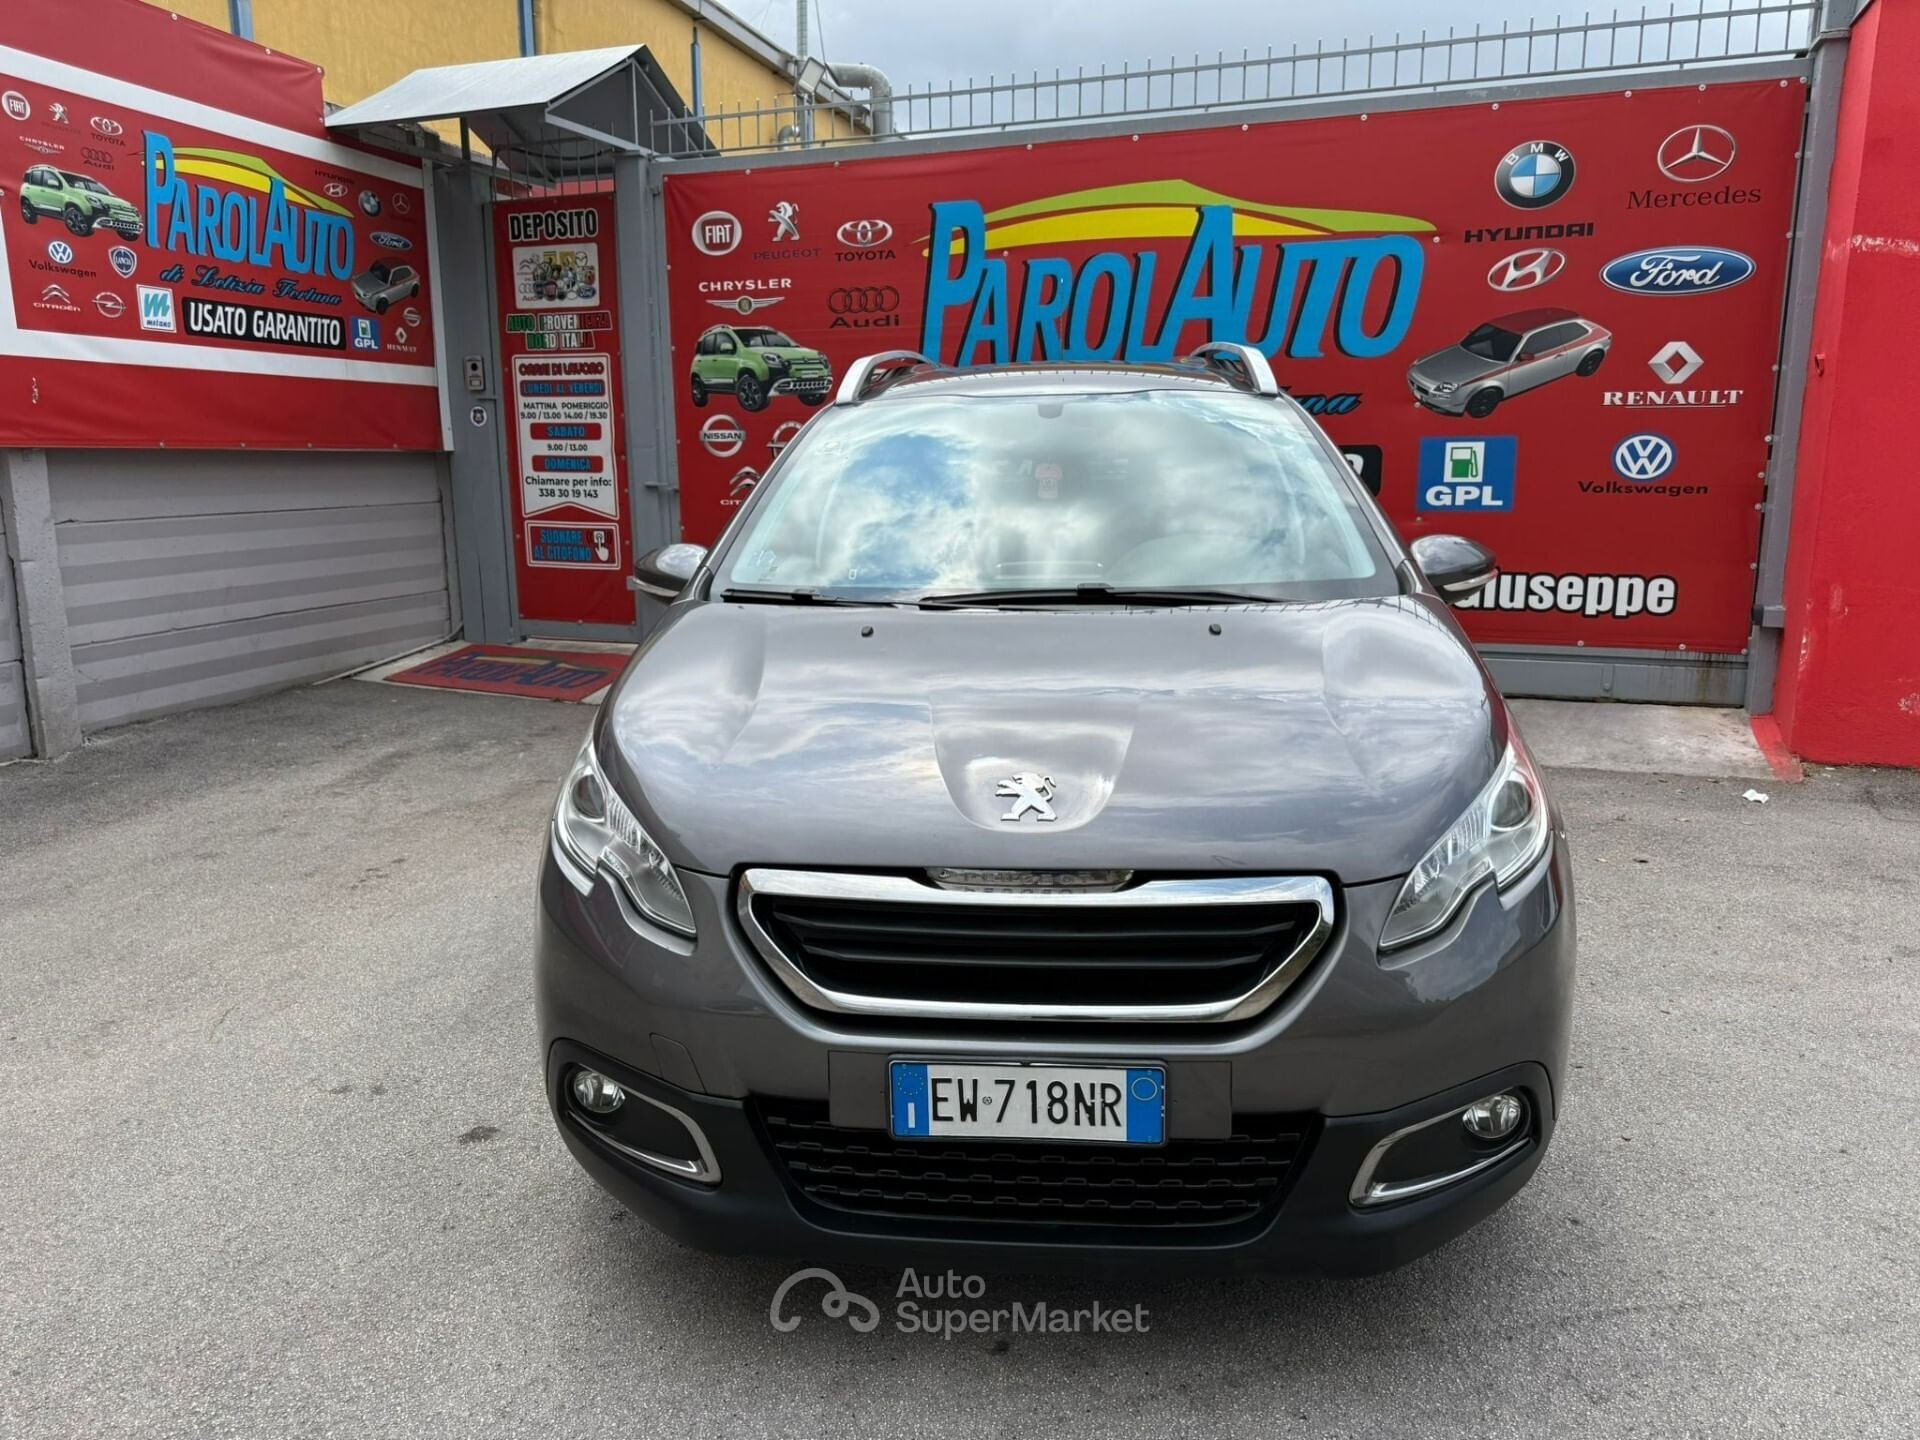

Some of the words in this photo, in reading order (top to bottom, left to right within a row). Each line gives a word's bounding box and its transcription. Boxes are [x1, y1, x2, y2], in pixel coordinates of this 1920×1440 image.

[9, 98, 25, 114] FIAT
[19, 135, 65, 150] CHRYSLER
[90, 132, 126, 146] TOYOTA
[83, 160, 115, 171] Audi
[1625, 185, 1763, 211] Mercedes
[509, 209, 597, 241] DEPOSITO
[1463, 221, 1595, 244] HYUNDAI
[377, 233, 404, 248] Ford
[704, 224, 732, 245] FIAT
[752, 247, 822, 261] PEUGEOT
[834, 249, 897, 262] TOYOTA
[28, 259, 97, 278] Volkswagen
[1629, 254, 1724, 288] Ford
[160, 264, 185, 282] di
[192, 265, 265, 295] Letizia
[273, 278, 343, 306] Fortuna
[698, 278, 792, 293] CHRYSLER
[189, 301, 247, 336] USATO
[253, 308, 341, 346] GARANTITO
[508, 315, 535, 331] AUTO
[829, 314, 900, 329] Audi
[354, 338, 379, 350] GPL
[528, 333, 557, 348] NORD
[1601, 389, 1744, 406] RENAULT
[523, 402, 558, 410] MATTINA
[561, 401, 609, 410] POMERIGGIO
[703, 432, 742, 440] NISSAN
[525, 476, 570, 486] Chiamare
[572, 478, 588, 488] per
[590, 477, 612, 487] info:
[1577, 480, 1709, 497] Volkswagen
[538, 488, 556, 497] 338
[558, 488, 570, 498] 30
[572, 489, 581, 498] 19
[583, 489, 599, 499] 143
[1425, 485, 1504, 507] GPL
[931, 1078, 978, 1123] EW
[994, 1079, 1122, 1127] 718NR
